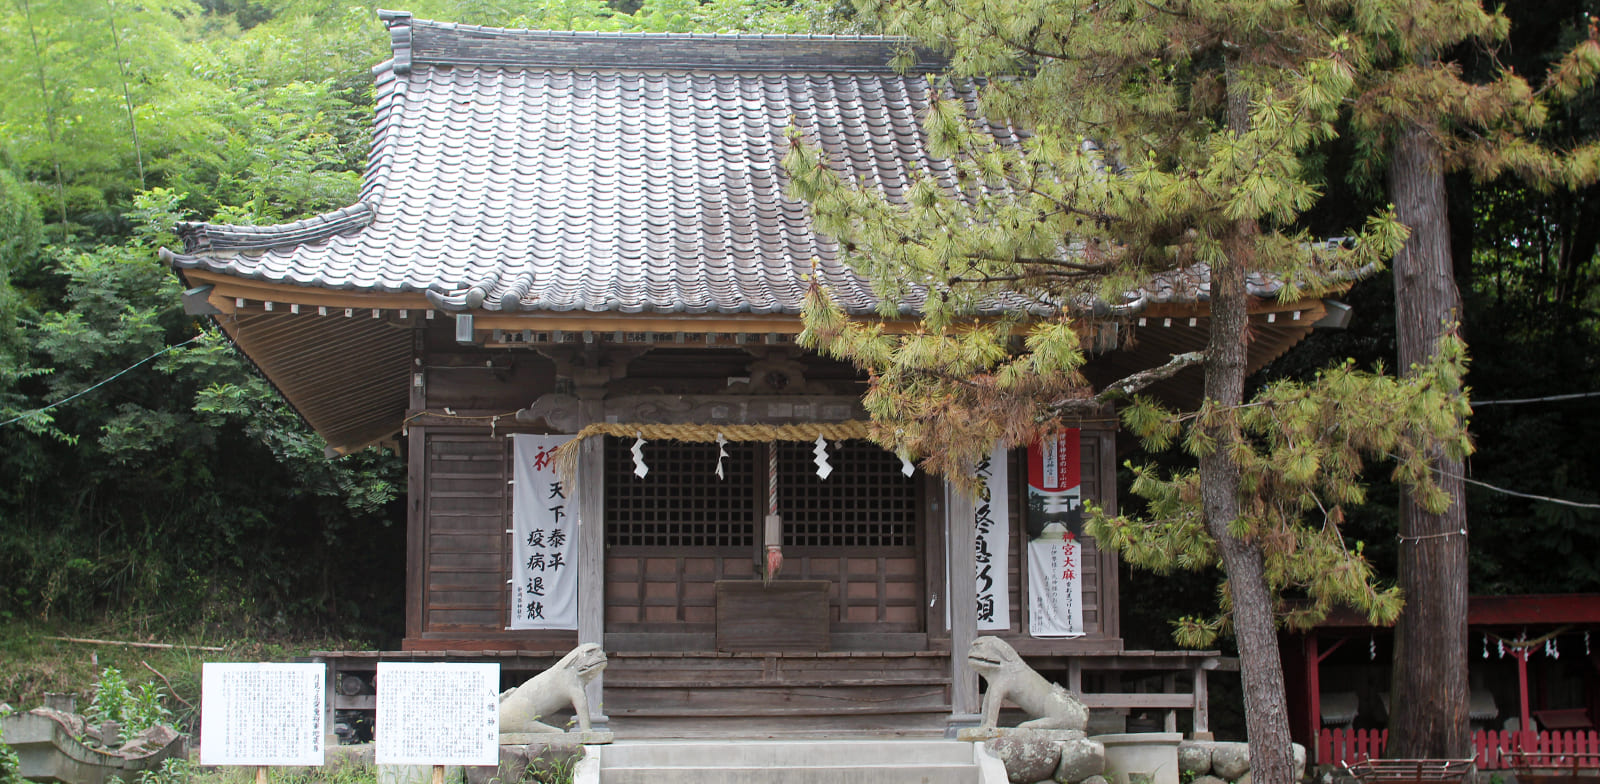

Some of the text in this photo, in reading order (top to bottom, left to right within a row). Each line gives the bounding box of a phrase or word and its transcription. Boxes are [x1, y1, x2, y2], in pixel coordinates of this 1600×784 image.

[533, 446, 558, 475] 祈
[547, 481, 566, 573] 天下泰平
[526, 528, 547, 620] 疫病退散
